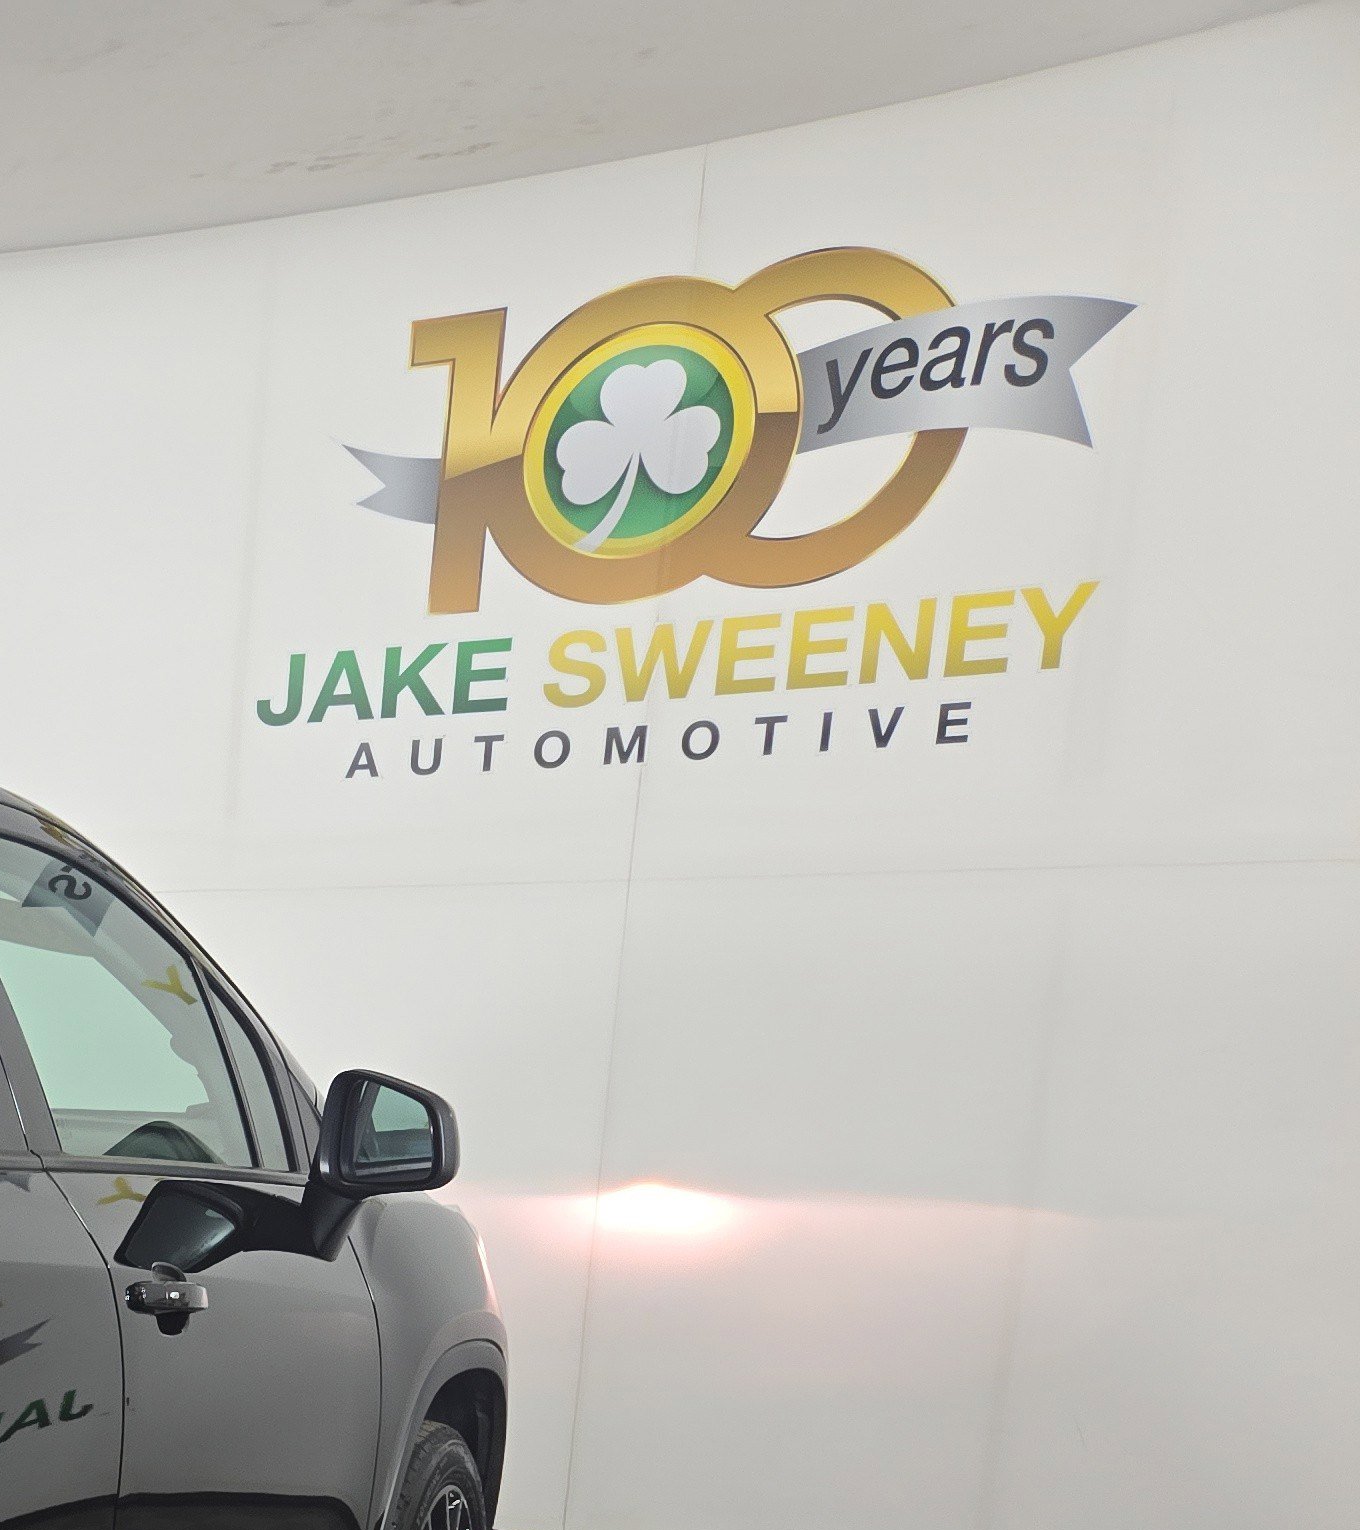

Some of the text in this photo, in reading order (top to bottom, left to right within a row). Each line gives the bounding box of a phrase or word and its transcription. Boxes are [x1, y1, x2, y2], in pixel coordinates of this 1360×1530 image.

[409, 245, 1056, 615] 100 years
[256, 580, 1102, 728] JAKE SWEENEY
[344, 700, 973, 780] AUTOMOTIVE
